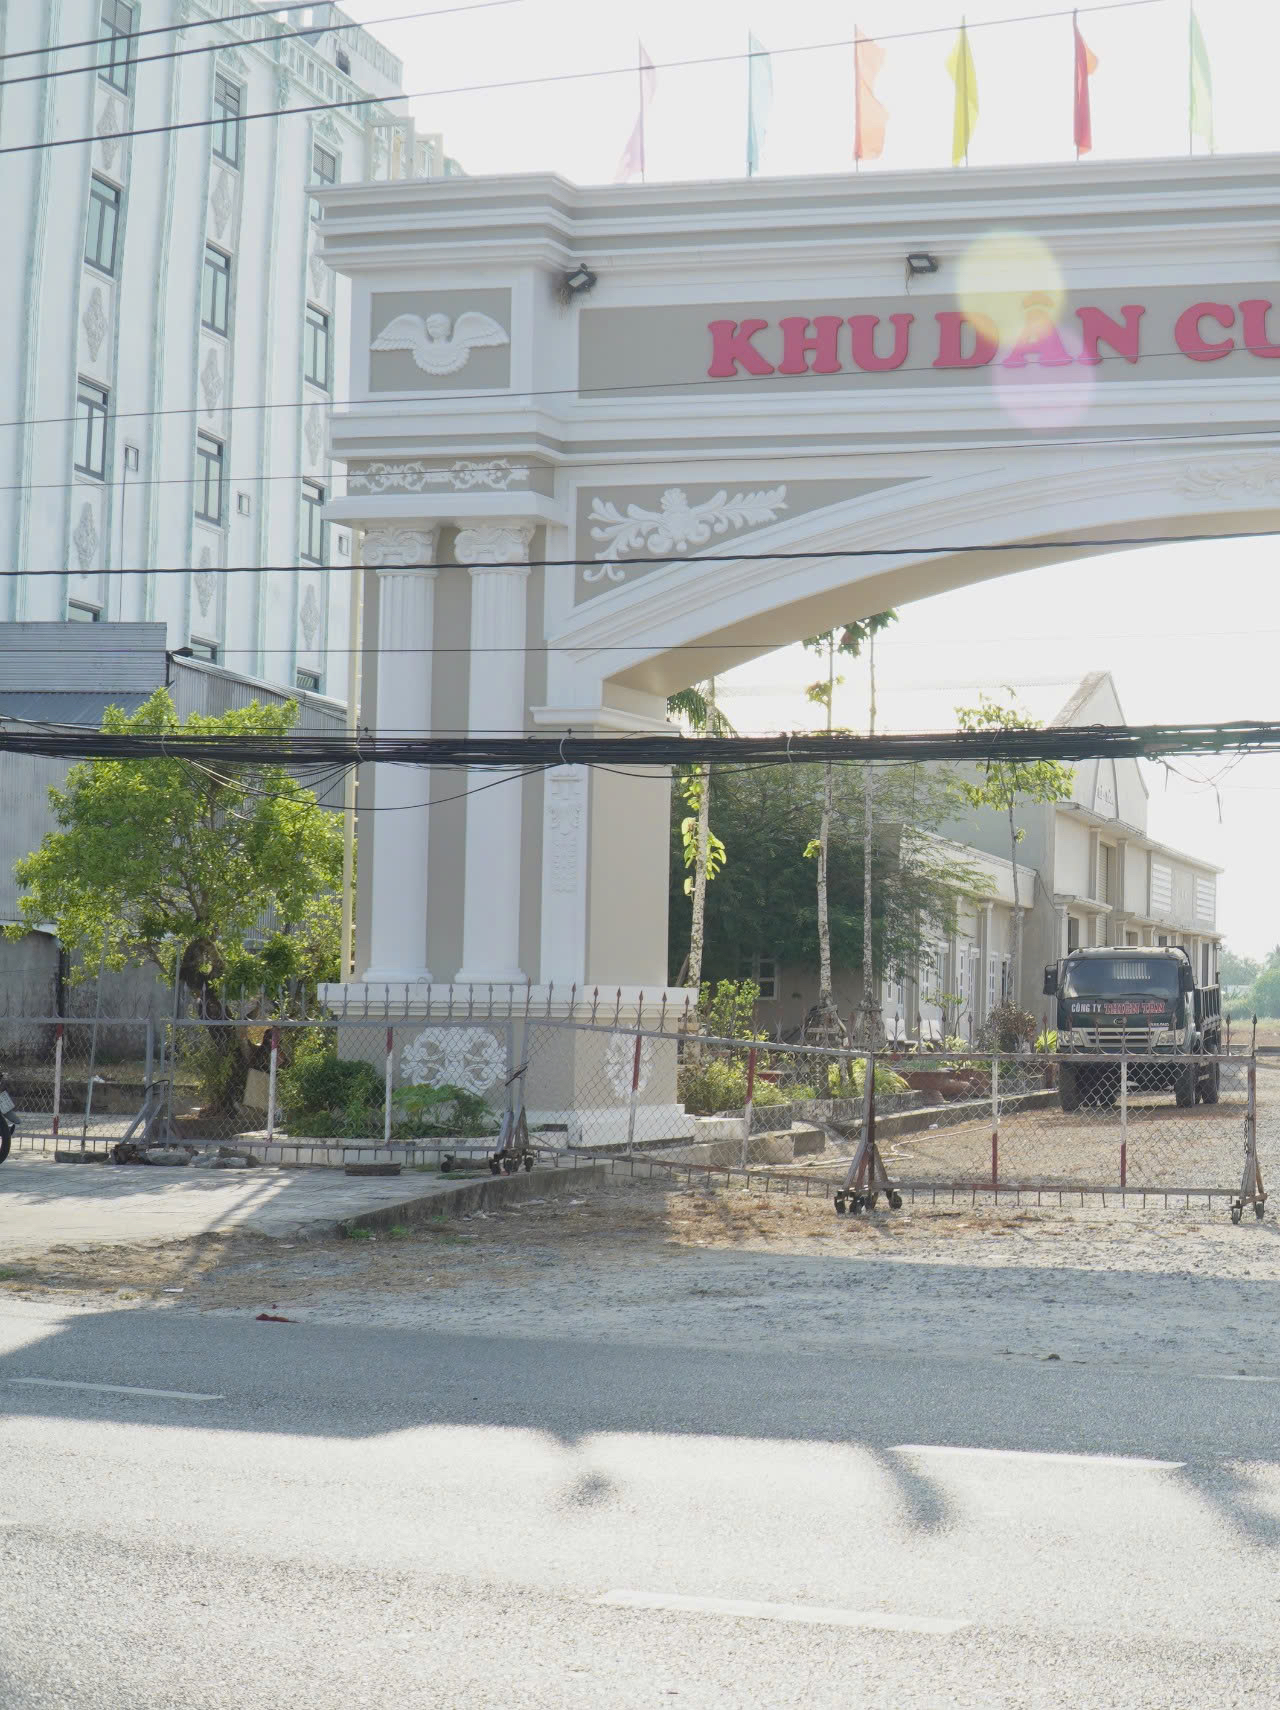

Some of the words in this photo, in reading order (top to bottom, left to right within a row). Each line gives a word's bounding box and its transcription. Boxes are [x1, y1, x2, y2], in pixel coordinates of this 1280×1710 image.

[707, 313, 914, 377] KHU
[932, 290, 1145, 370] DÂN
[1071, 1003, 1090, 1013] CÔNG
[1093, 1003, 1101, 1013] TY
